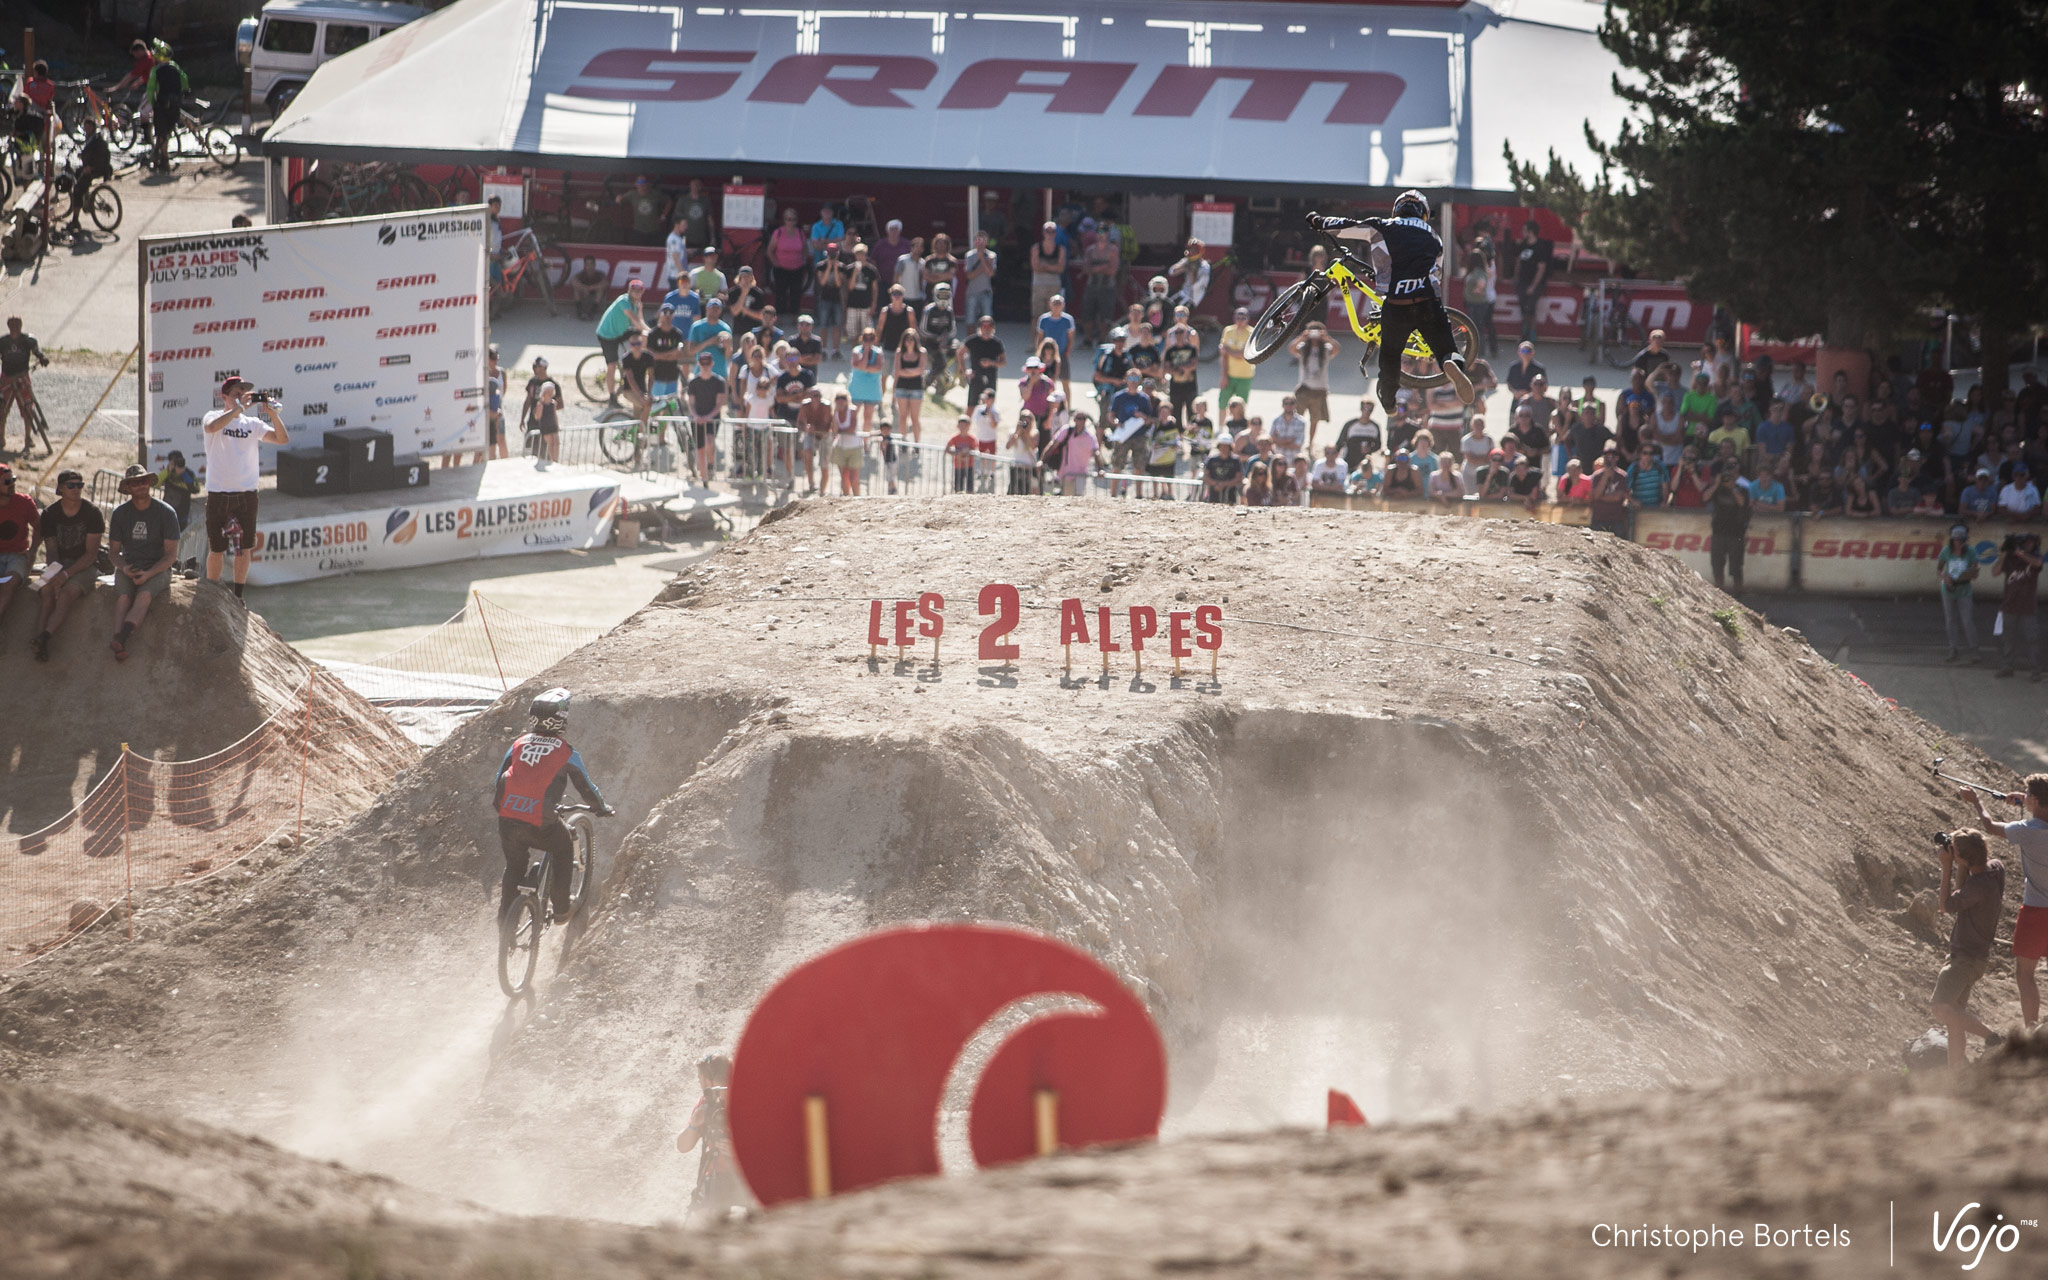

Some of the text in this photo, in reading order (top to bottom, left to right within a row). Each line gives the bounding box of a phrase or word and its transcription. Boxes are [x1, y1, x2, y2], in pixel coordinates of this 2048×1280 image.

[563, 48, 1407, 125] SRAM
[150, 235, 264, 257] CRANKWORX
[150, 250, 239, 271] LES 2 ALPES
[150, 264, 238, 284] JULY 9-12 2015
[376, 273, 437, 291] SRAM
[262, 286, 325, 303] SRAM
[1394, 276, 1427, 295] FOX
[150, 296, 213, 313] SRAM
[419, 294, 478, 312] SRAM
[308, 305, 371, 322] SRAM
[193, 317, 257, 335] SRAM
[376, 322, 437, 340] SRAM
[262, 336, 326, 353] SRAM
[147, 346, 212, 363] SRAM
[303, 361, 339, 372] GIANT
[342, 380, 377, 391] GIANT
[384, 394, 419, 405] GIANT
[366, 440, 376, 462] 1
[316, 465, 329, 484] 2
[408, 467, 420, 485] 3
[1811, 538, 1943, 561] SRAM
[867, 583, 1223, 661] LES 2 ALPES
[502, 793, 539, 815] FOX
